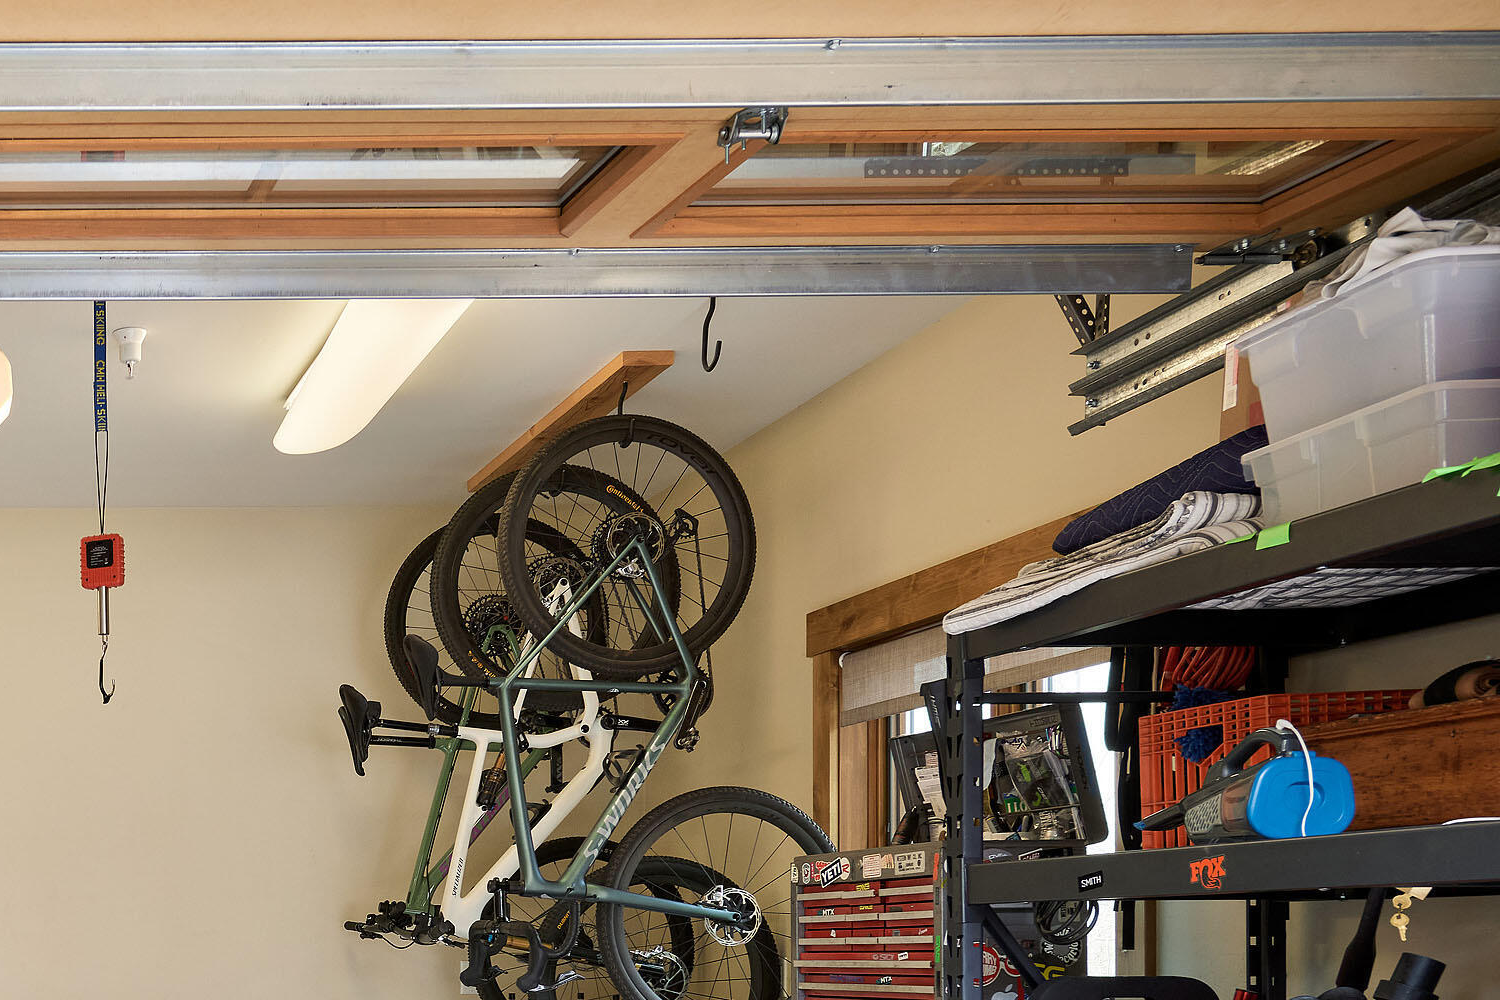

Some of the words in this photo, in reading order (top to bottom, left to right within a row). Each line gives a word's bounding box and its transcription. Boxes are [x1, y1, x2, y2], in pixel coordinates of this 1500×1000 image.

[584, 735, 666, 867] S-WORKS
[452, 857, 464, 896] SPECIALIZED
[821, 862, 842, 883] YETI
[1080, 875, 1102, 888] SMITH
[1190, 856, 1226, 886] FOX
[822, 908, 835, 916] MTX
[880, 976, 892, 984] MTX
